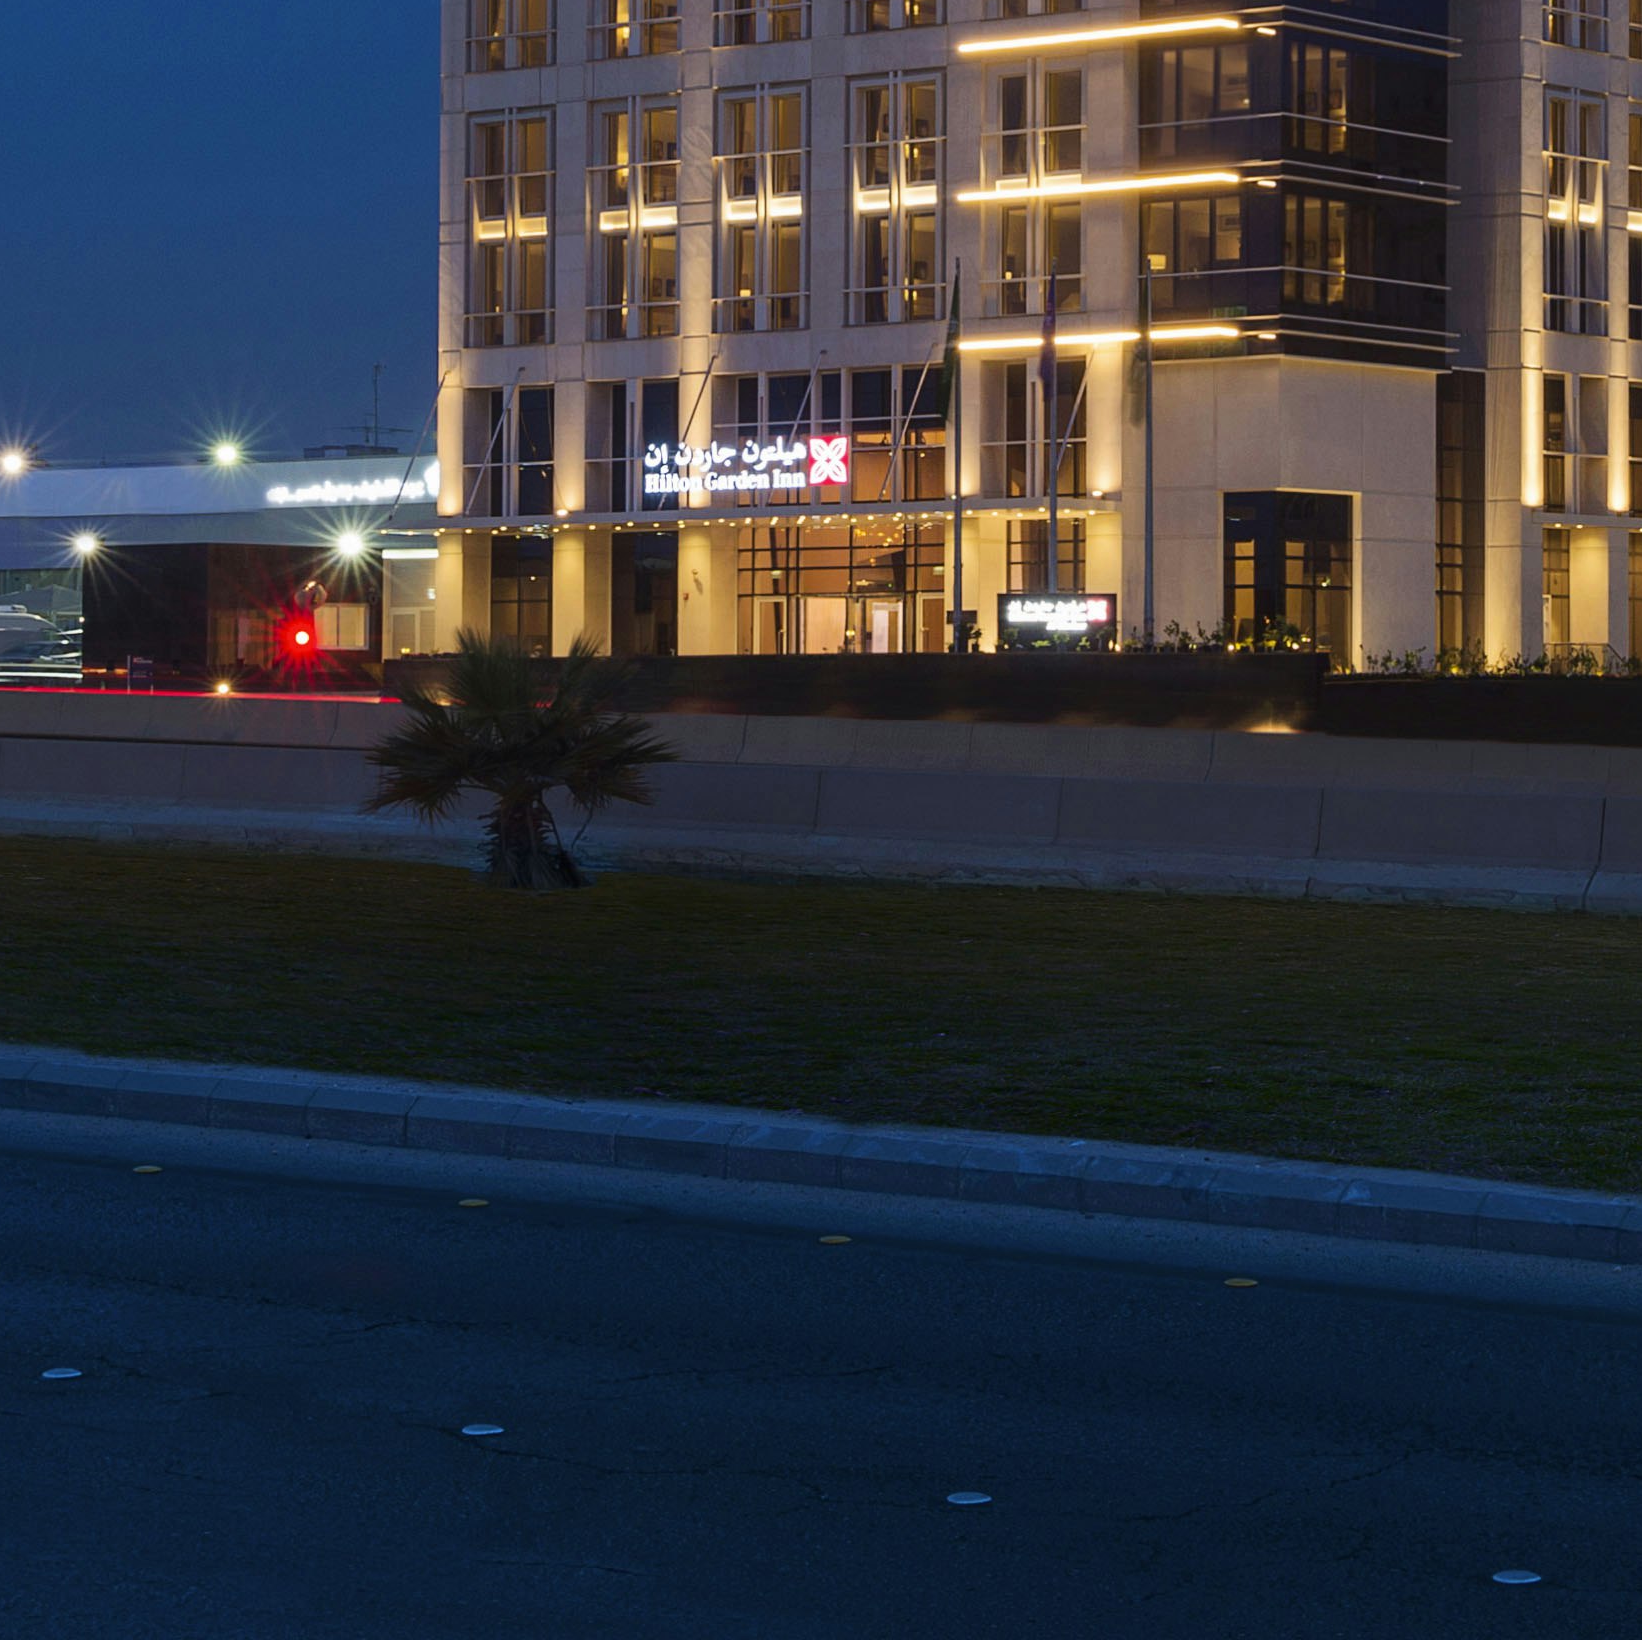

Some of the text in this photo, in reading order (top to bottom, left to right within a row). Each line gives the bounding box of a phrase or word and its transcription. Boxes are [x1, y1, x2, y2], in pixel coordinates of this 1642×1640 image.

[645, 443, 669, 474] إن
[674, 441, 736, 472] جاردن
[645, 468, 806, 493] Hilton Garden Inn
